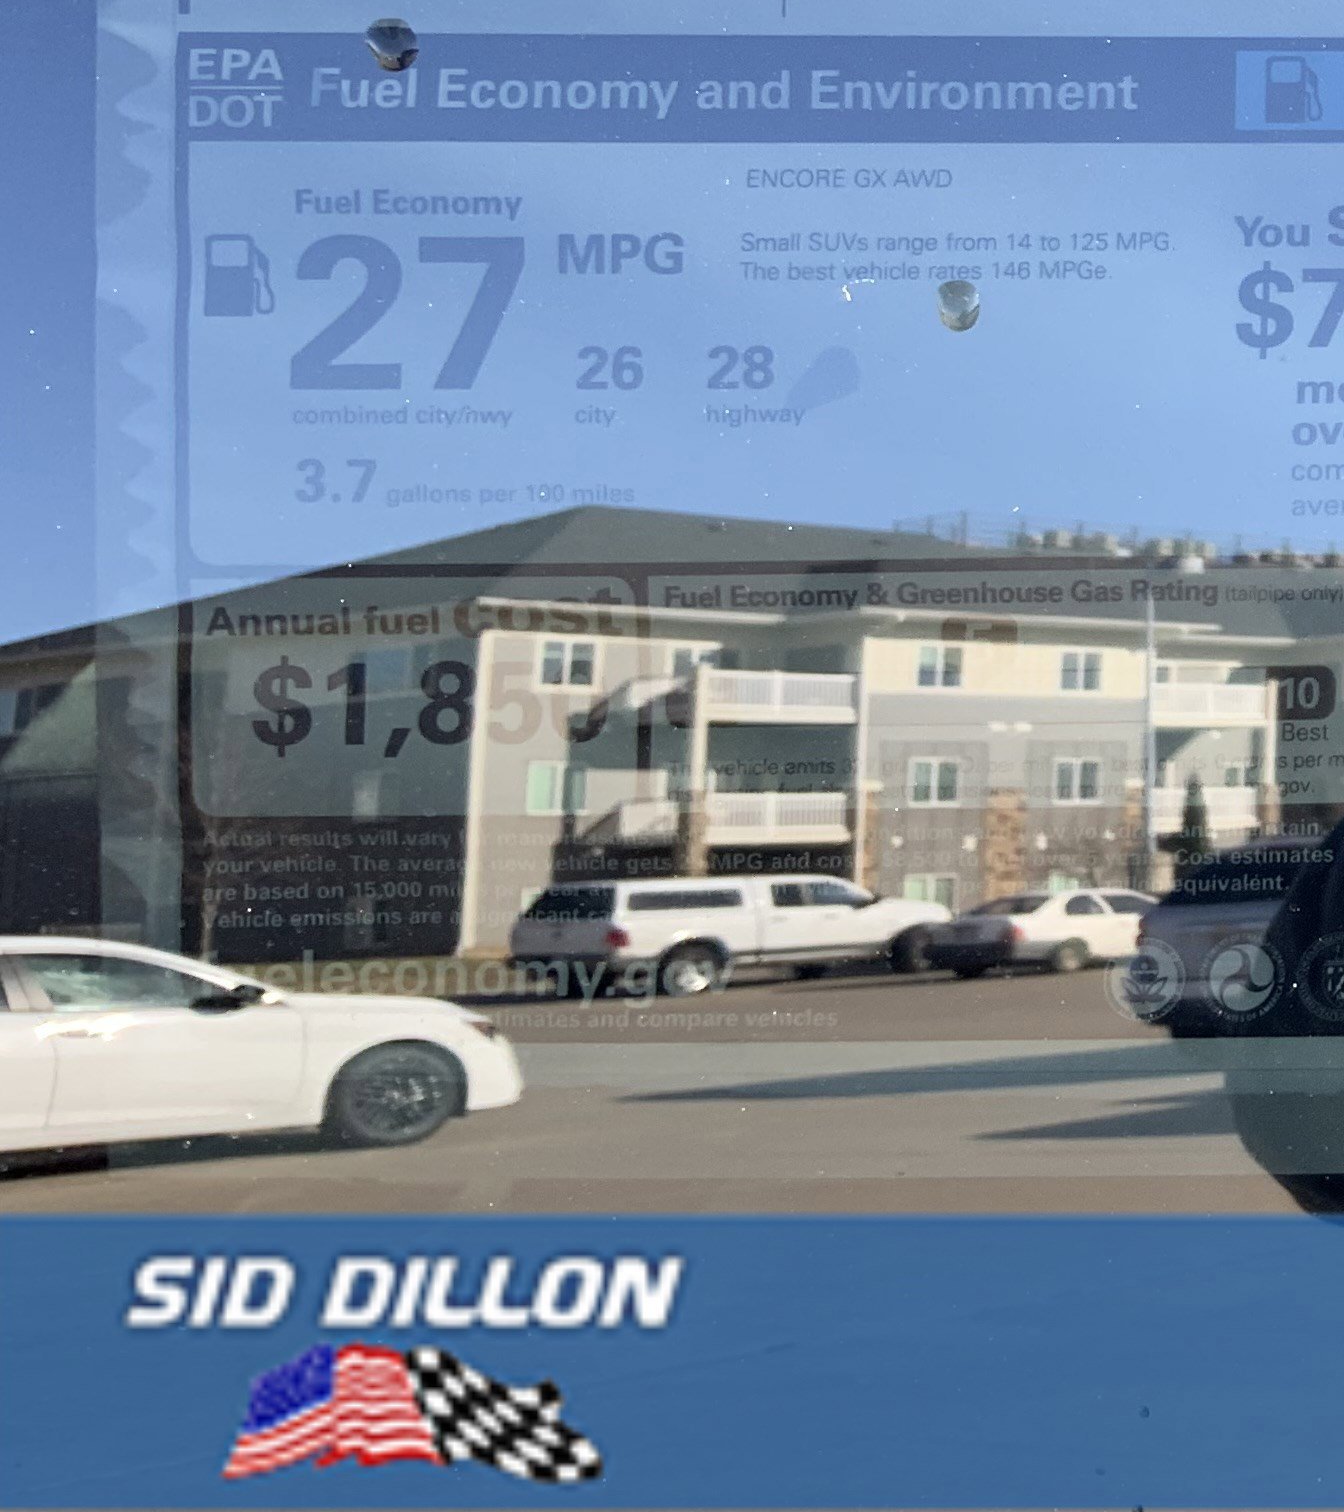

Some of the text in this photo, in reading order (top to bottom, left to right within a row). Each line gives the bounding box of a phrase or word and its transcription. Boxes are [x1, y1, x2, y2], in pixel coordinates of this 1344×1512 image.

[190, 48, 282, 80] EPA
[188, 92, 282, 127] DOT
[312, 68, 1138, 119] Fuel Economy and Environment
[1235, 216, 1309, 247] You
[558, 232, 683, 274] MPG
[290, 233, 525, 389] 27
[577, 346, 643, 390] 26
[707, 346, 773, 389] 28
[575, 405, 615, 426] city
[707, 398, 812, 428] highway
